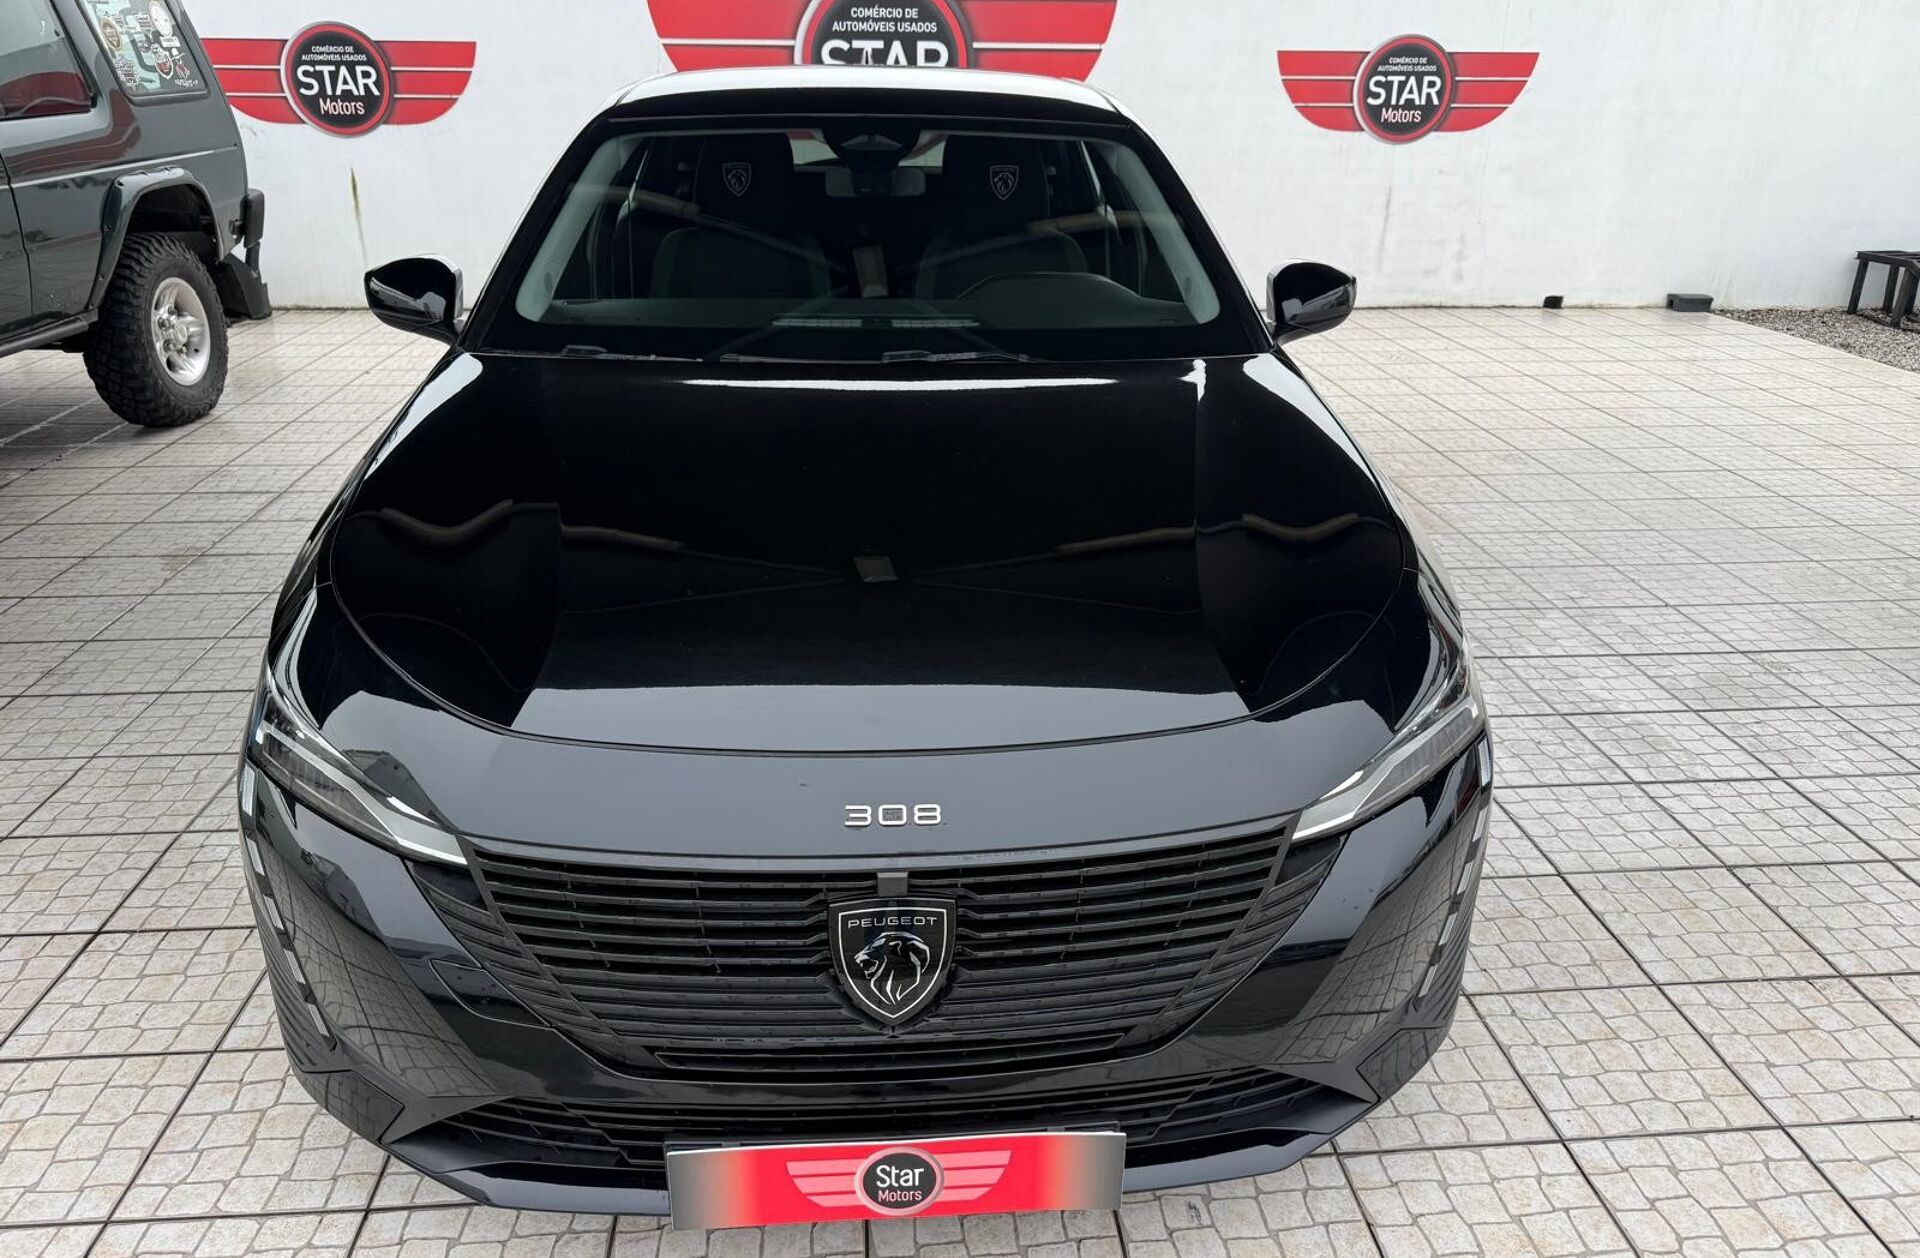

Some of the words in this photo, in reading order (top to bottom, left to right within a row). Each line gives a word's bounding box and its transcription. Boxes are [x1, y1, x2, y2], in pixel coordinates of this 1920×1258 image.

[851, 5, 903, 18] COMÉRCIO
[905, 8, 919, 18] DE
[832, 19, 896, 32] AUTOMÓVEIS
[897, 22, 937, 33] USADOS
[311, 45, 344, 53] COMÉRCIO
[302, 53, 340, 61] AUTOMÓVEIS
[1389, 56, 1418, 64] COMÉRCIO
[1377, 64, 1413, 72] AUTOMÓVEIS
[297, 65, 380, 96] STAR
[1366, 75, 1442, 106] STAR
[319, 98, 365, 115] Motors
[1380, 107, 1421, 123] Motors
[844, 803, 942, 827] 308
[847, 917, 938, 929] PEUGEOT
[876, 1164, 925, 1188] Star
[878, 1189, 922, 1202] Motors
